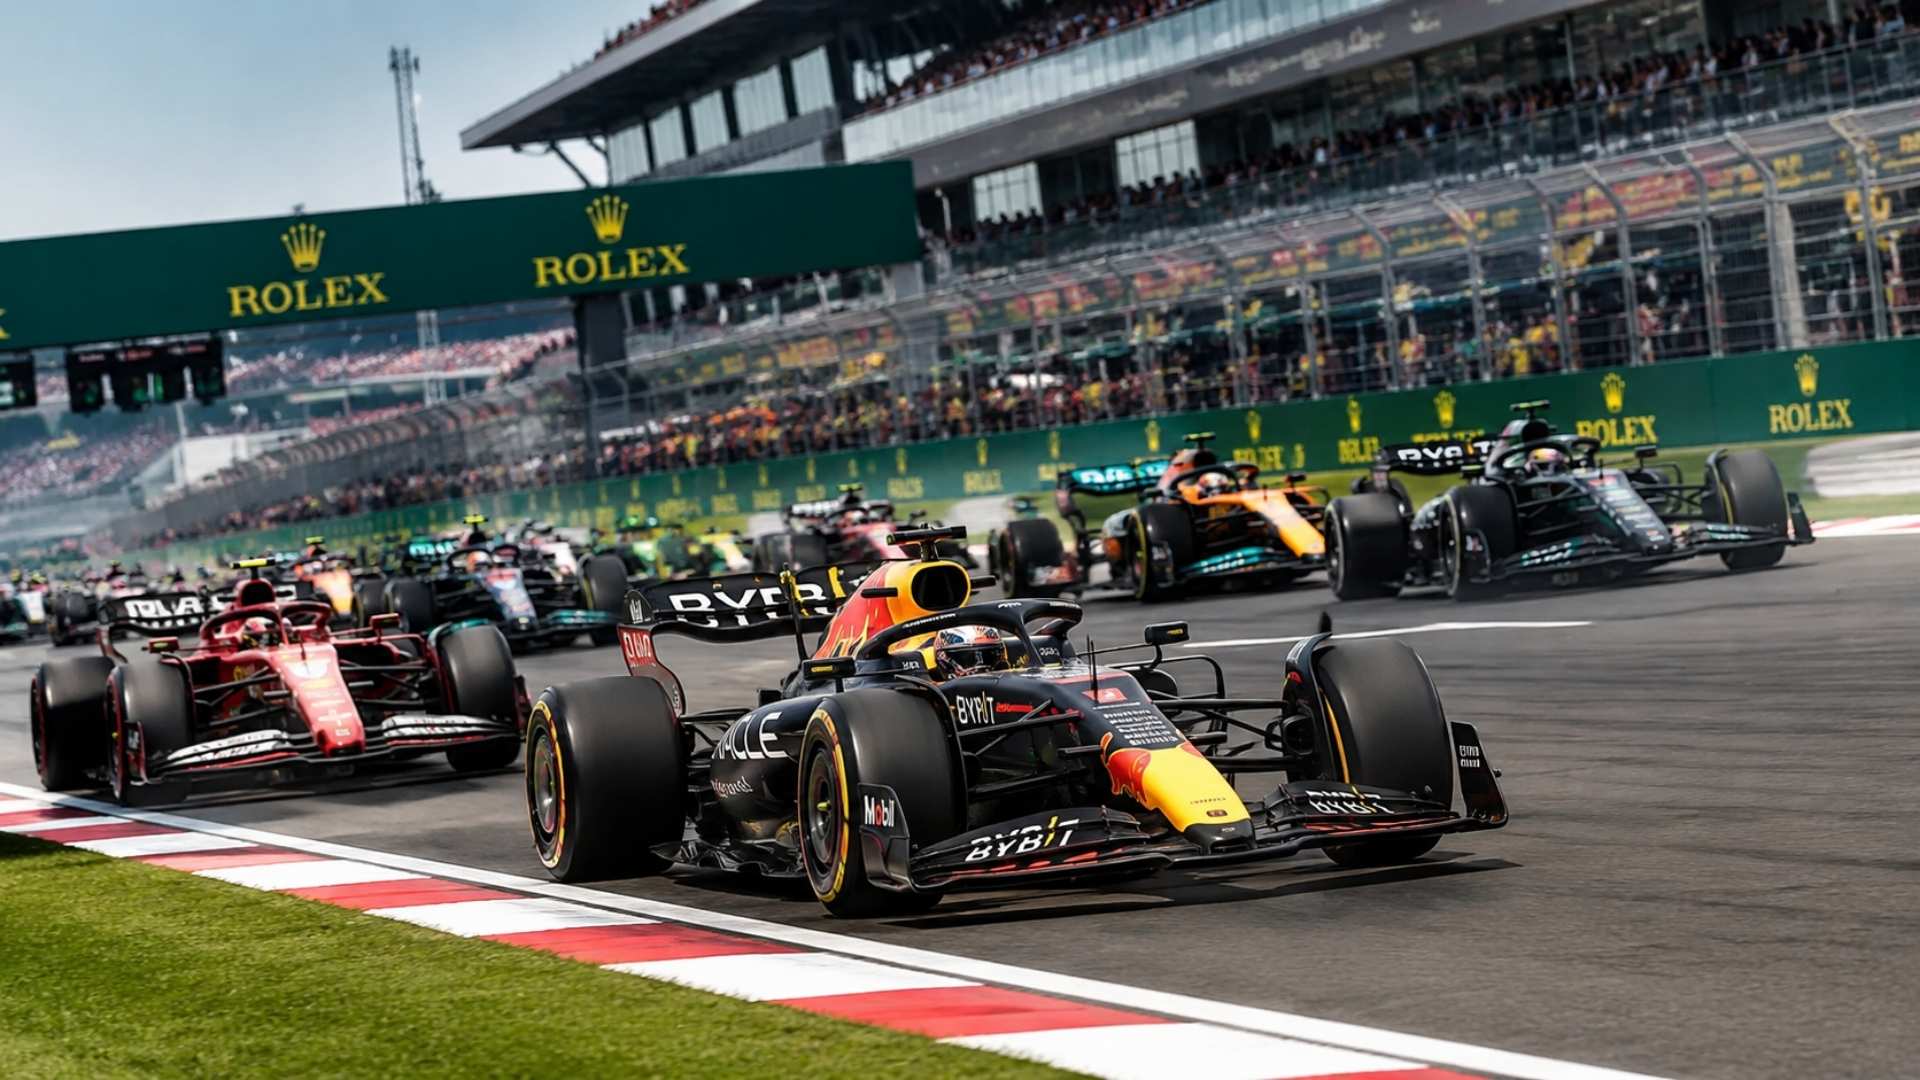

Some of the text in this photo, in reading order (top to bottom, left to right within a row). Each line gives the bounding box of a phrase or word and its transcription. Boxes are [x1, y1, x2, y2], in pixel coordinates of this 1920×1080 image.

[532, 243, 690, 288] ROLEX
[227, 272, 390, 317] ROLEX
[1576, 415, 1658, 447] ROLEX
[1769, 399, 1853, 434] ROLEX
[864, 794, 896, 828] Mobil
[965, 815, 1080, 862] BYBIT
